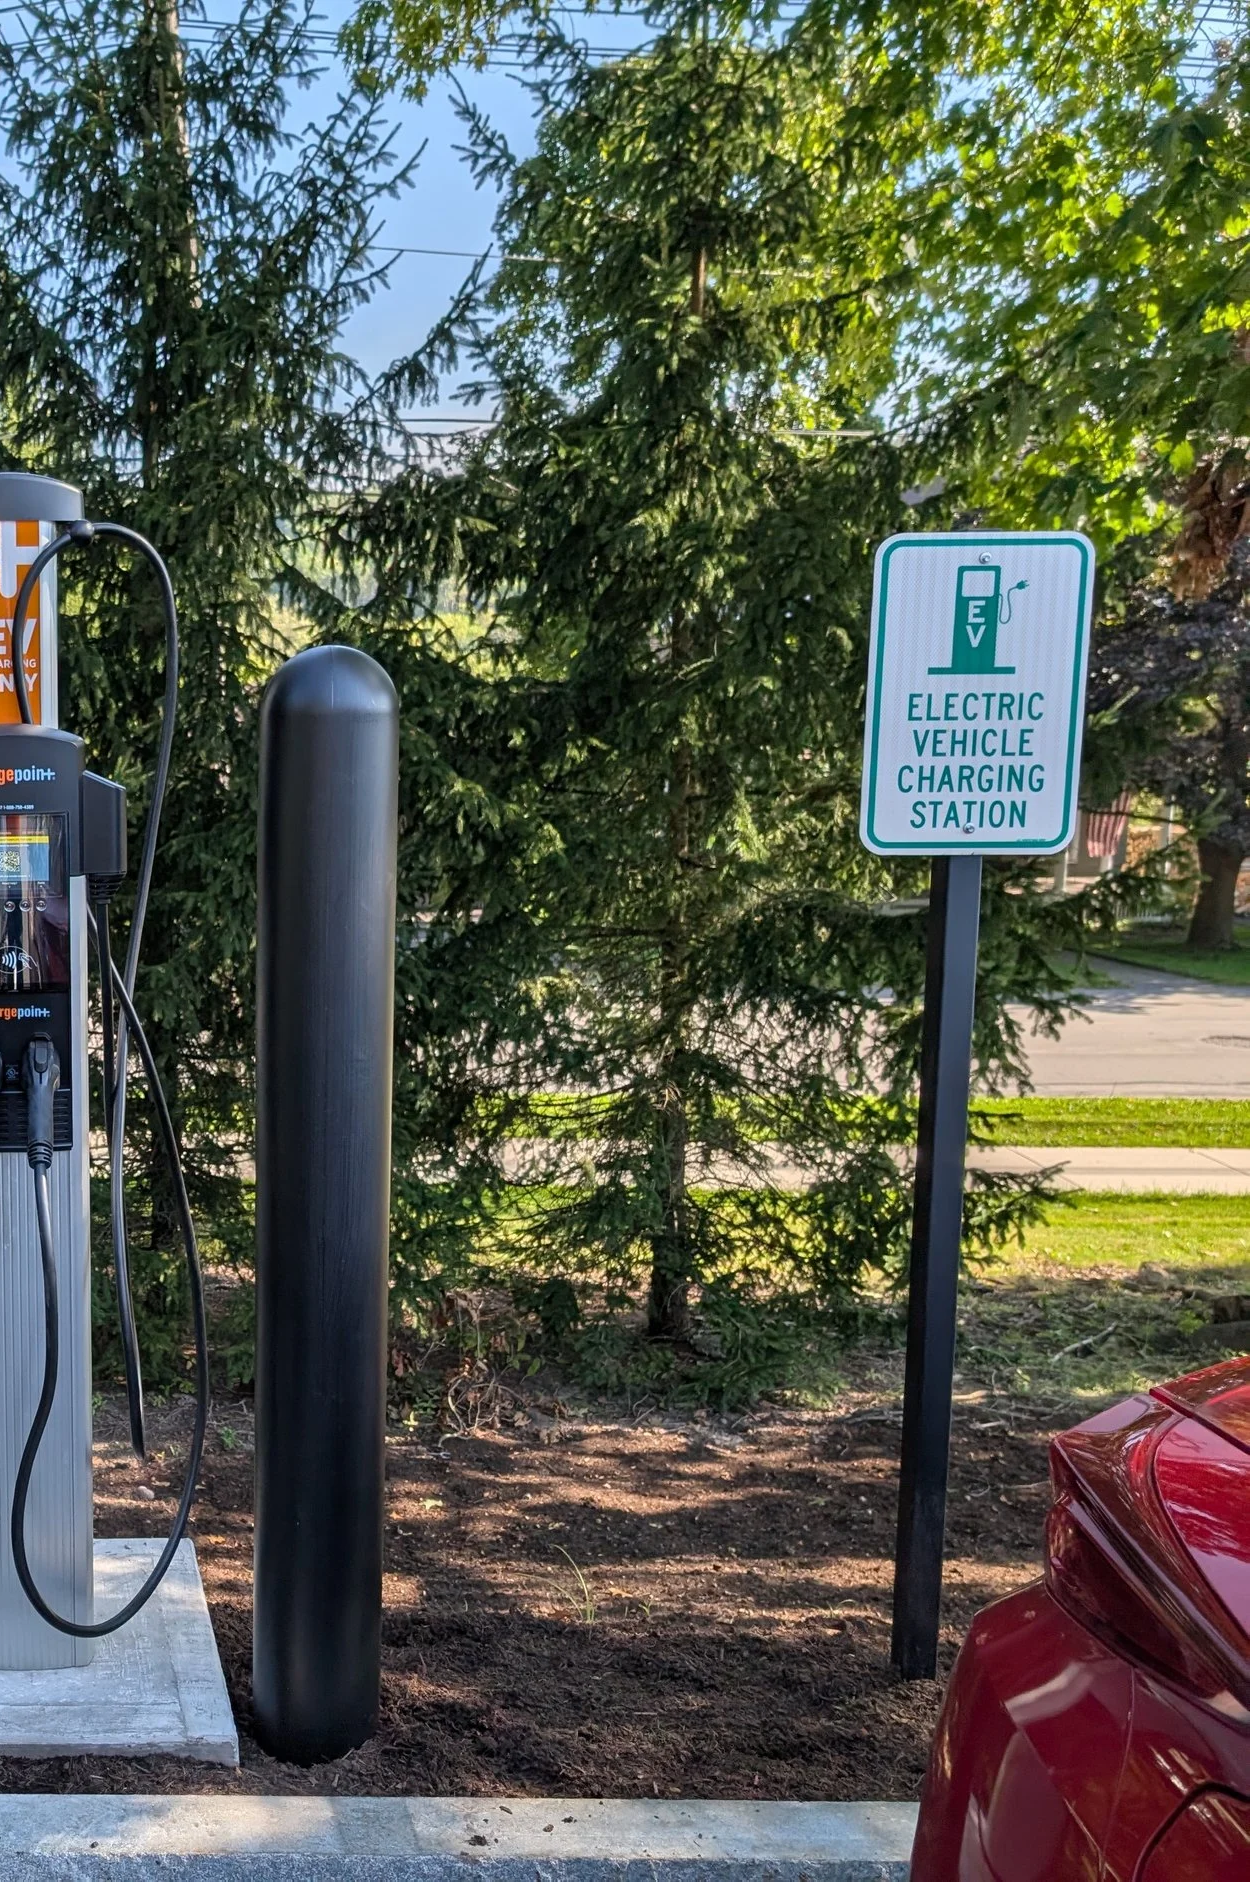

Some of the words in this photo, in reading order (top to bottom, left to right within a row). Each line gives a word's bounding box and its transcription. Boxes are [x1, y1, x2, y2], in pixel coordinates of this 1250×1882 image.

[965, 600, 986, 648] EV
[907, 692, 1045, 721] ELECTRIC
[912, 728, 1035, 757] VEHICLE
[897, 764, 1045, 793] CHARGING
[909, 800, 1027, 829] STATION
